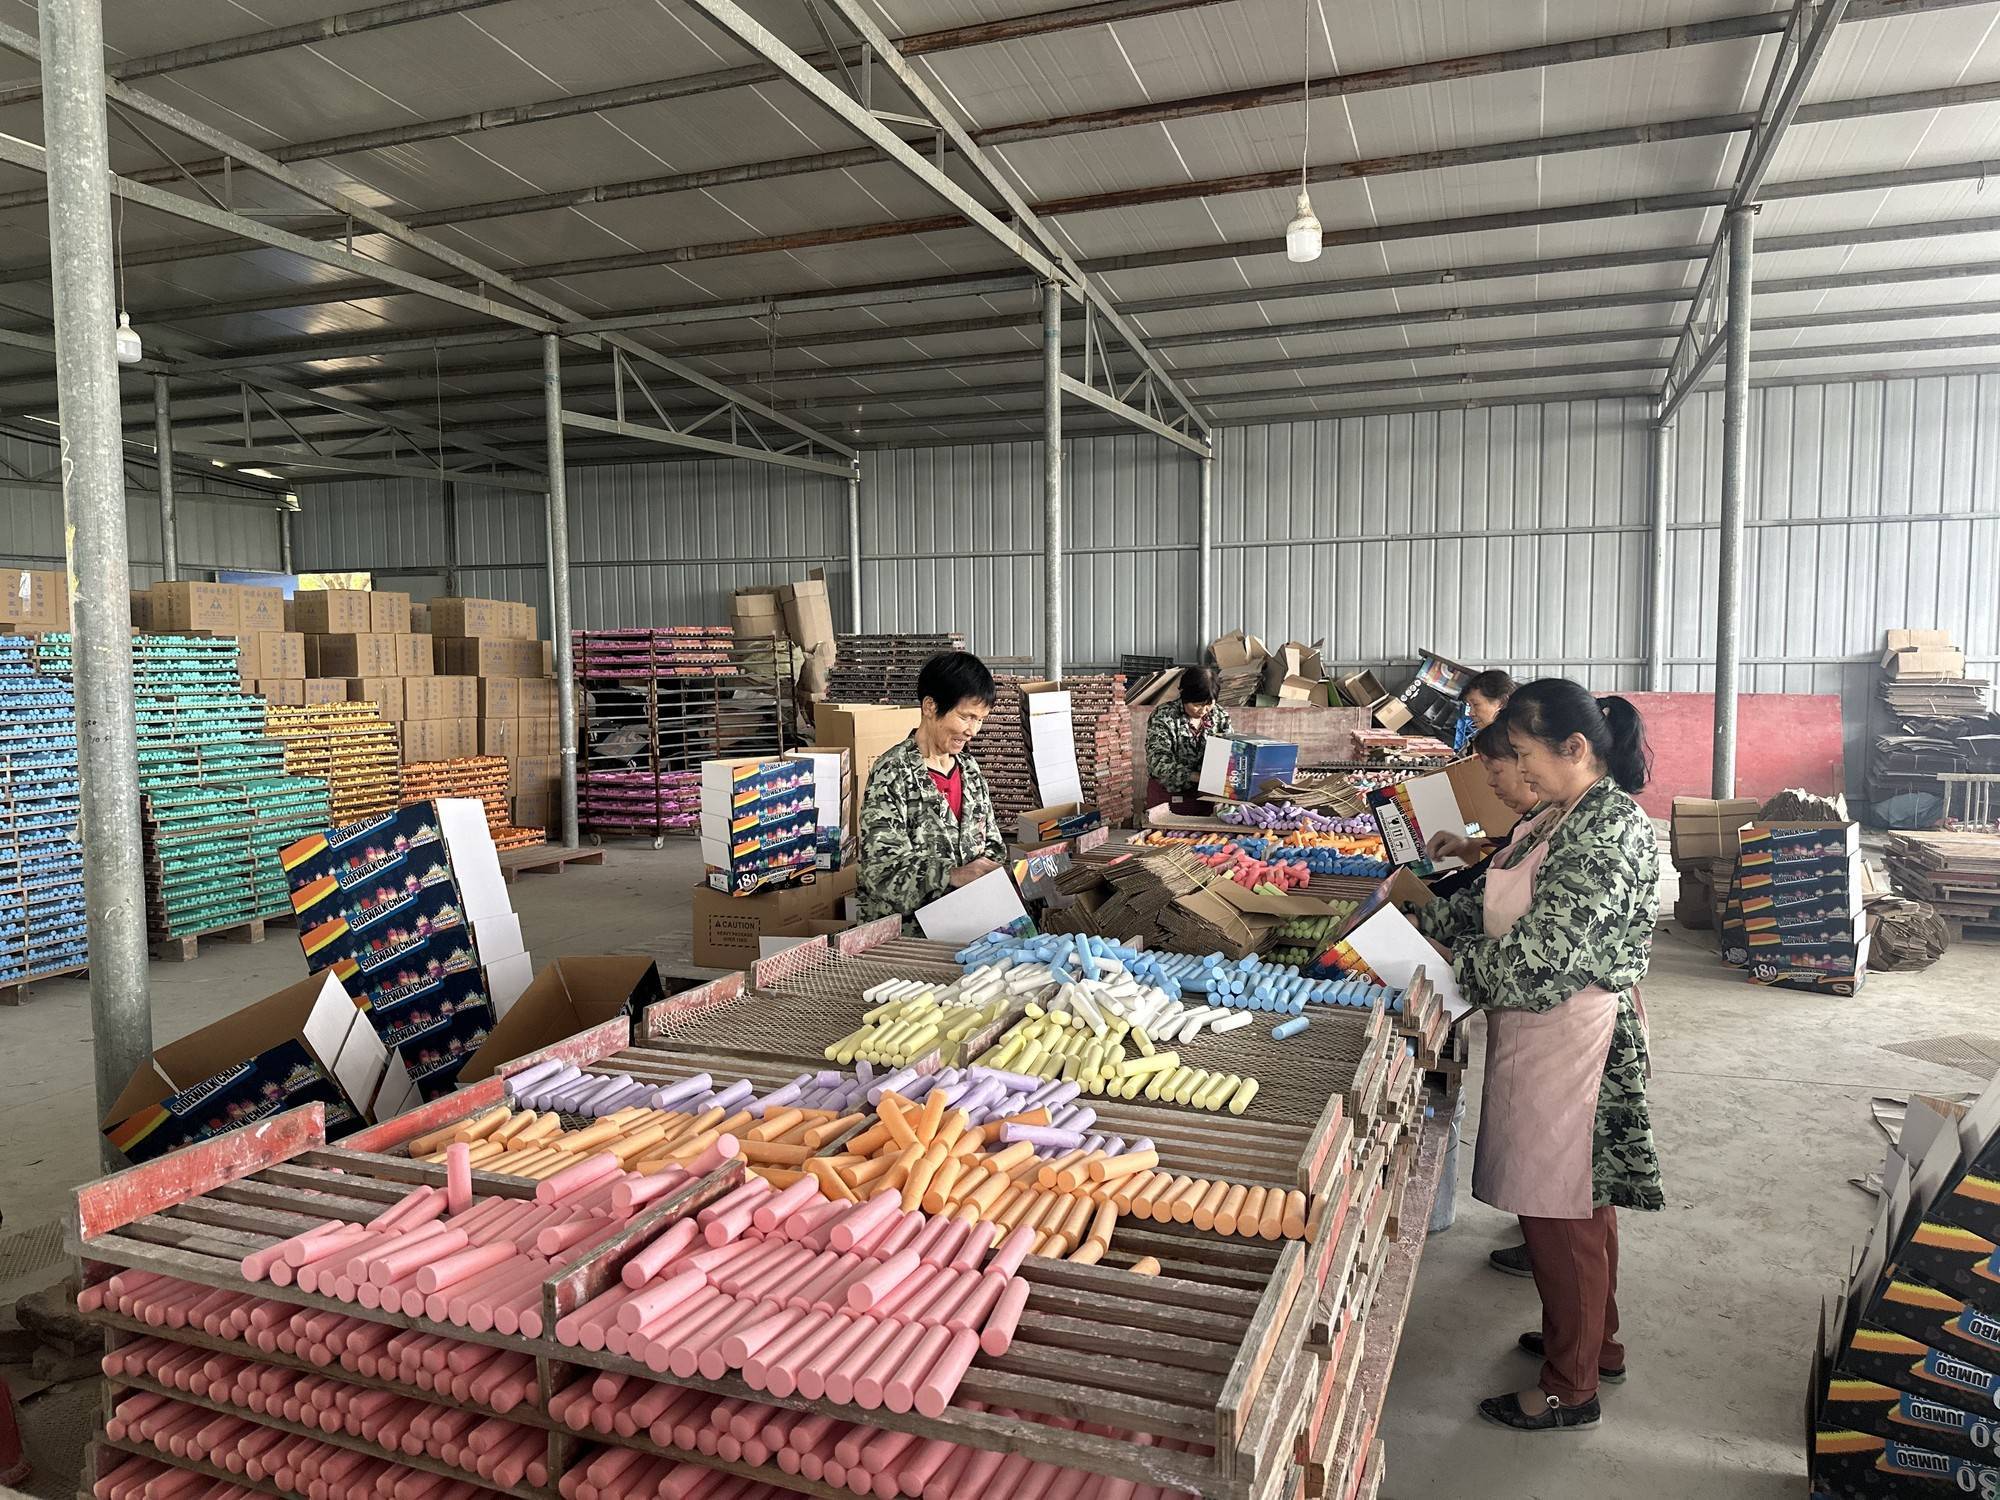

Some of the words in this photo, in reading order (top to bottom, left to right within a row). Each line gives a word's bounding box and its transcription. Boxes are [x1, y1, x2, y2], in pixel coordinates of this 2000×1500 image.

[330, 820, 368, 846] SIDEWALK
[341, 861, 378, 888] SIDEWALK
[736, 873, 758, 889] 180
[351, 903, 388, 929] SIDEWALK
[721, 920, 755, 930] CAUTION
[362, 945, 400, 970] SIDEWALK
[1752, 963, 1777, 978] 180
[374, 984, 414, 1009] SIDEWALK
[384, 1023, 423, 1048] SIDEWALK
[171, 1076, 219, 1114] SIDEWALK
[1936, 1360, 1991, 1389] JUMBO
[1911, 1403, 1964, 1426] JUMBO
[1897, 1450, 1950, 1472] JUMBO
